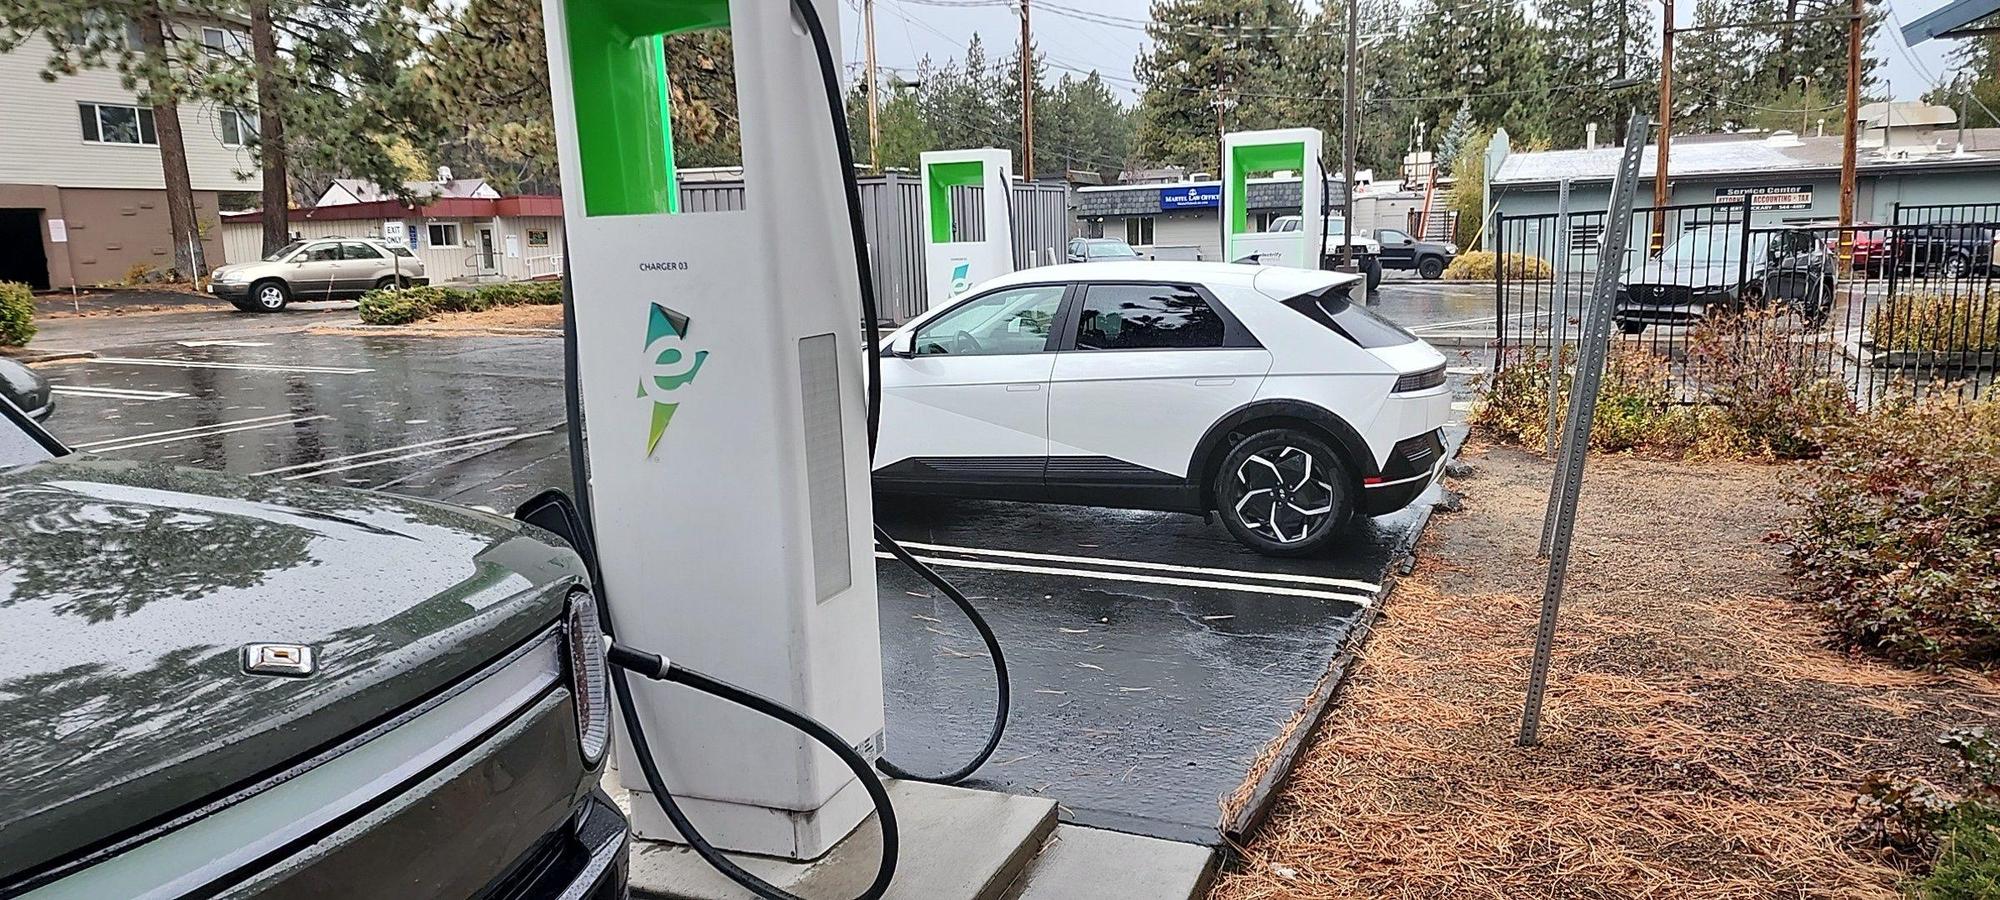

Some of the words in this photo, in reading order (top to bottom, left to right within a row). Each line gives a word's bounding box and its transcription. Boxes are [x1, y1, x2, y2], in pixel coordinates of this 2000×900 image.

[1767, 186, 1801, 194] Center
[1753, 195, 1792, 203] ACCOUNTING
[1798, 194, 1809, 202] TAX
[387, 226, 400, 234] EXIT
[387, 236, 401, 244] ONLY
[639, 262, 677, 271] CHARGER
[679, 261, 688, 270] 03
